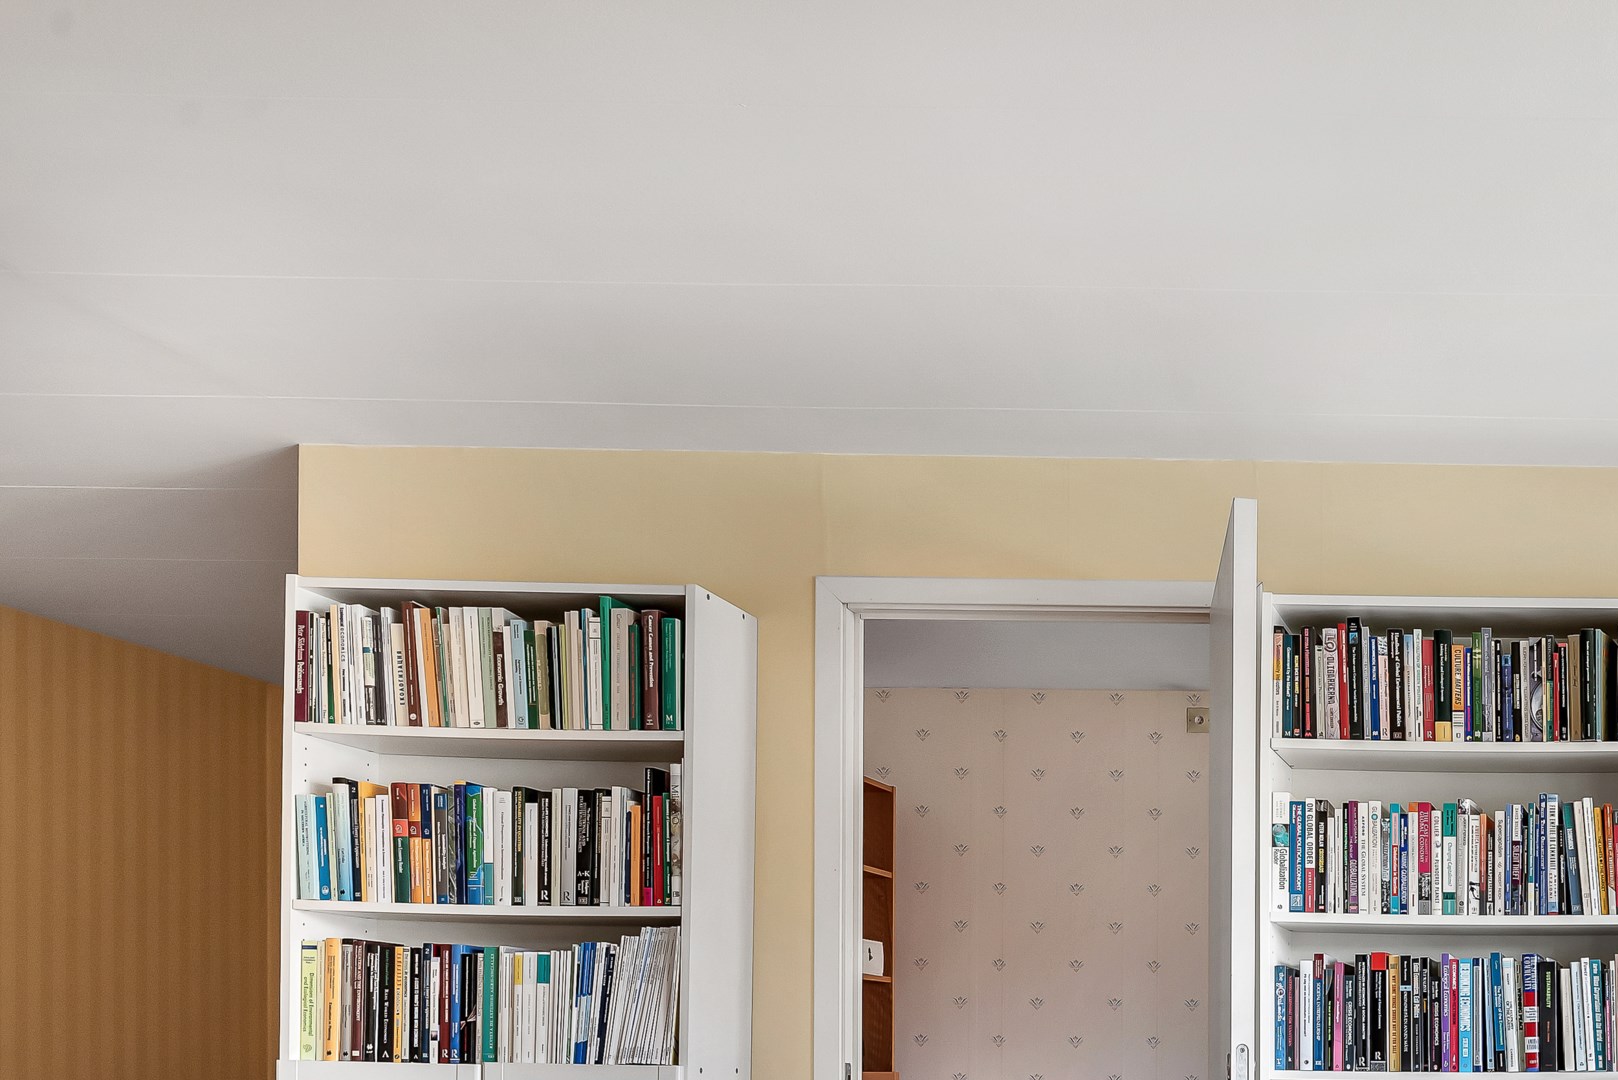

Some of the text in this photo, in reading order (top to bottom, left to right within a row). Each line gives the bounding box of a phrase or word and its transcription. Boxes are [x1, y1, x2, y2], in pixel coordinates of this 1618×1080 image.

[1327, 657, 1335, 704] OLIGARKERNA
[1307, 803, 1313, 812] ON
[1278, 849, 1288, 889] Globalization
[1460, 997, 1470, 1031] ECONOMICS
